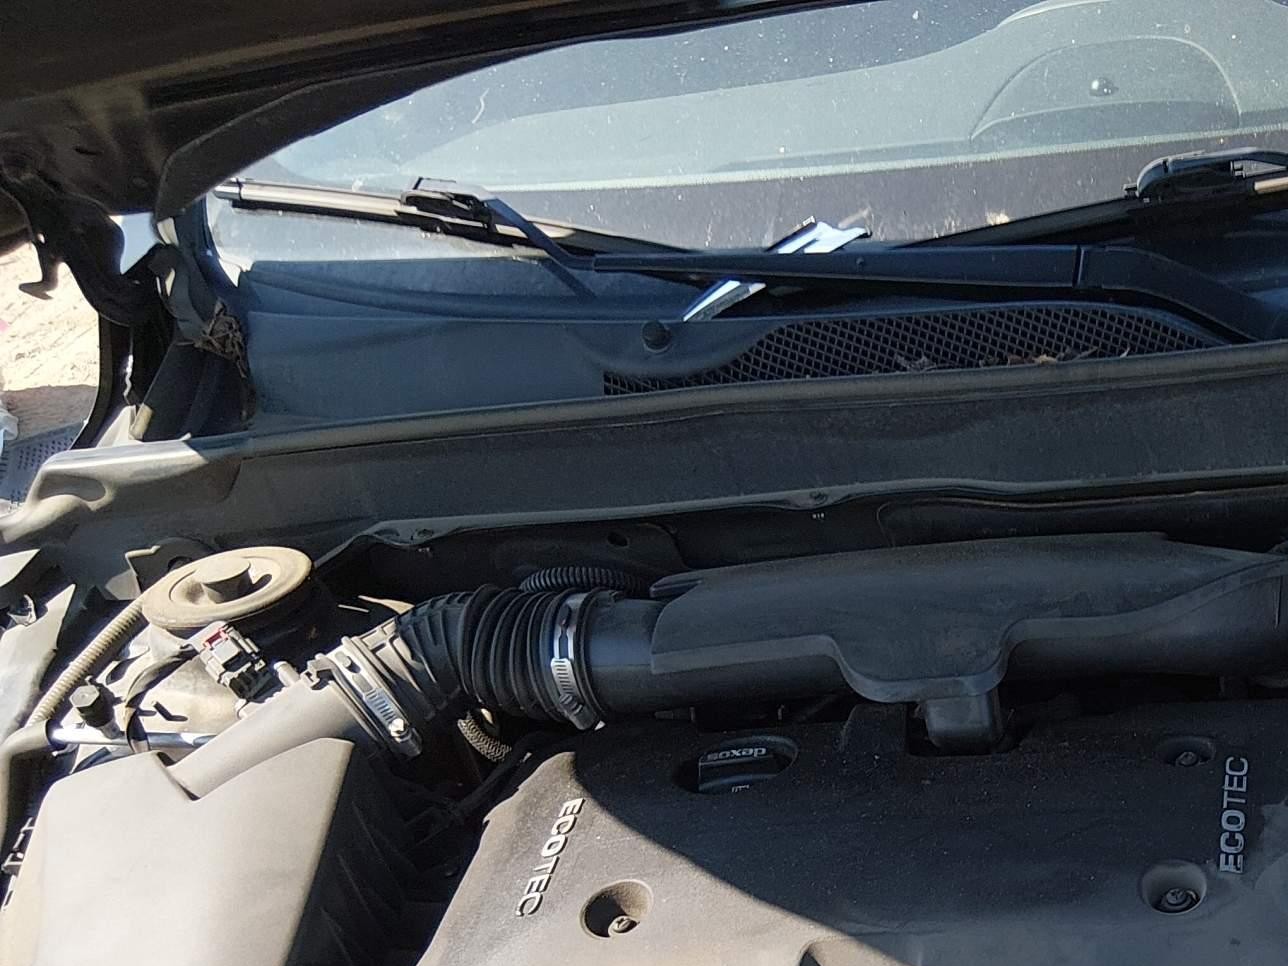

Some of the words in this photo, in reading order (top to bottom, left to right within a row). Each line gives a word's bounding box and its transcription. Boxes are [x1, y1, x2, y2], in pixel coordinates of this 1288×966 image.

[707, 747, 767, 760] dexos
[516, 797, 585, 917] ECOTEC
[1220, 756, 1249, 873] ECOTEC
